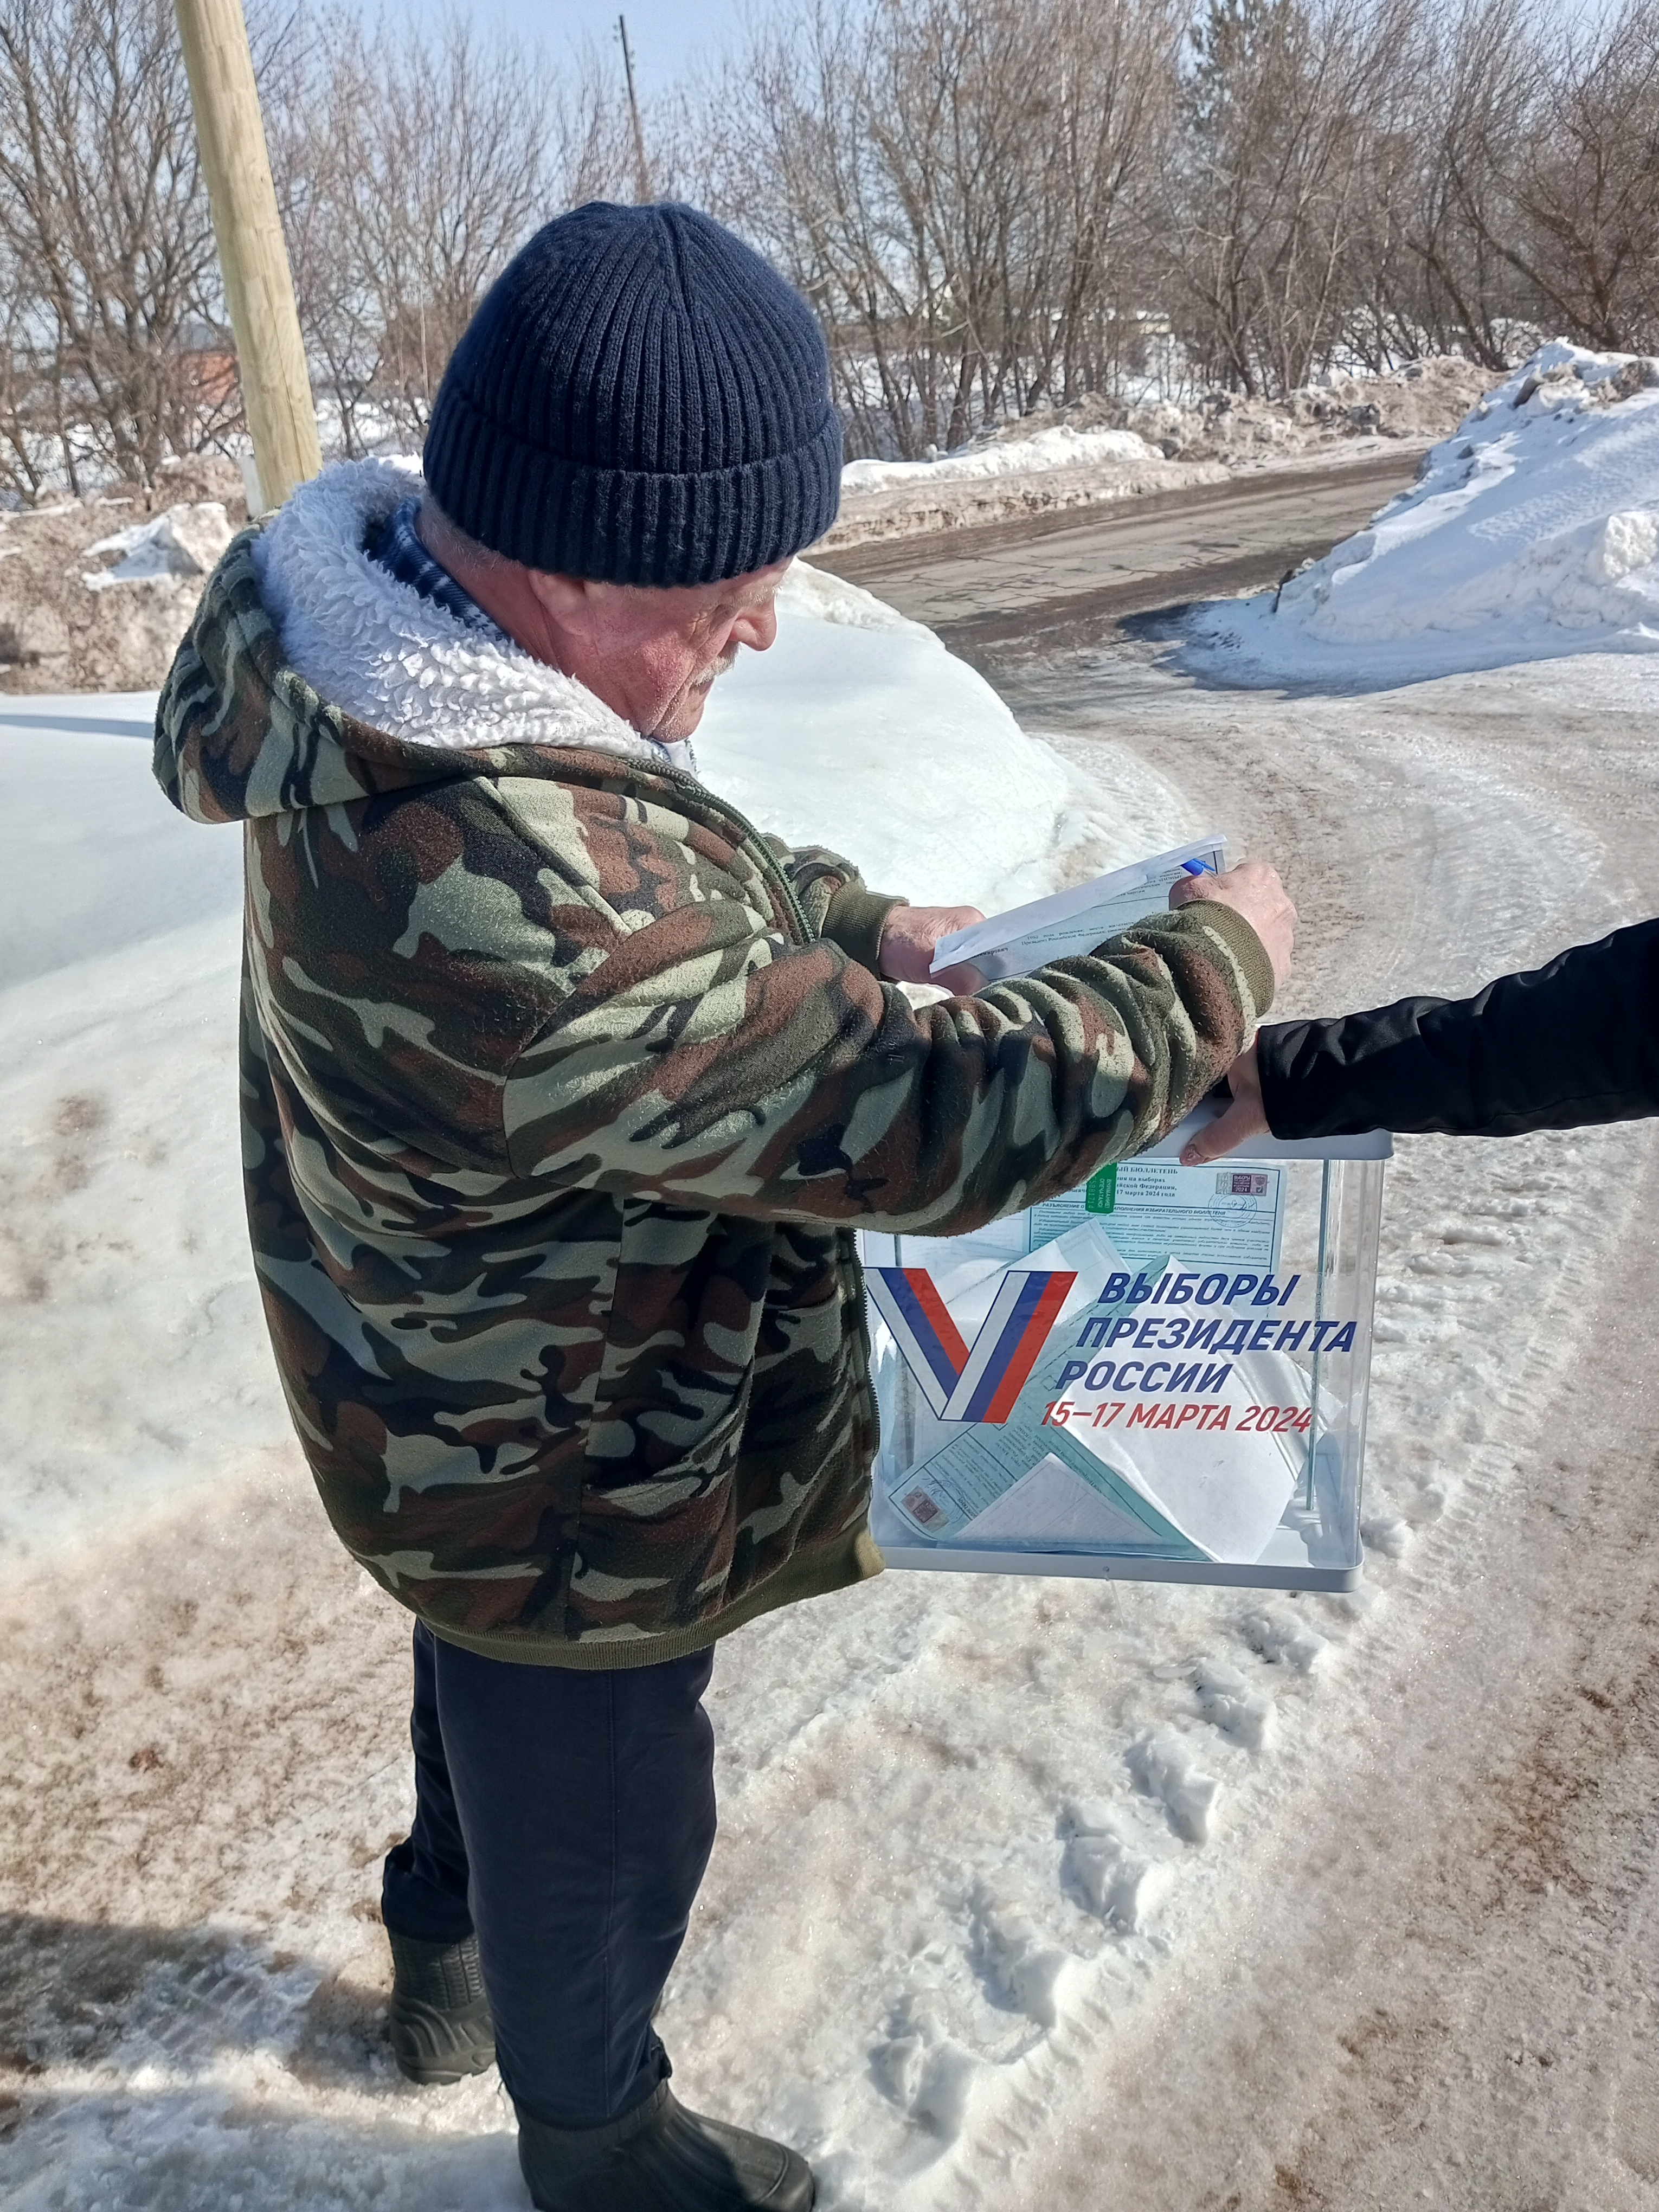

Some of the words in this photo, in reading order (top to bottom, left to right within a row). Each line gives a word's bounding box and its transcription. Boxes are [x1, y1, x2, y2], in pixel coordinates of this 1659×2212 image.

[1097, 1272, 1302, 1307] ВЫБОРЫ
[1076, 1317, 1358, 1355] ПРЕЗИДЕНТА
[1054, 1360, 1233, 1393] РОССИИ
[1126, 1403, 1232, 1431] МАРТА
[1235, 1405, 1313, 1433] 2024
